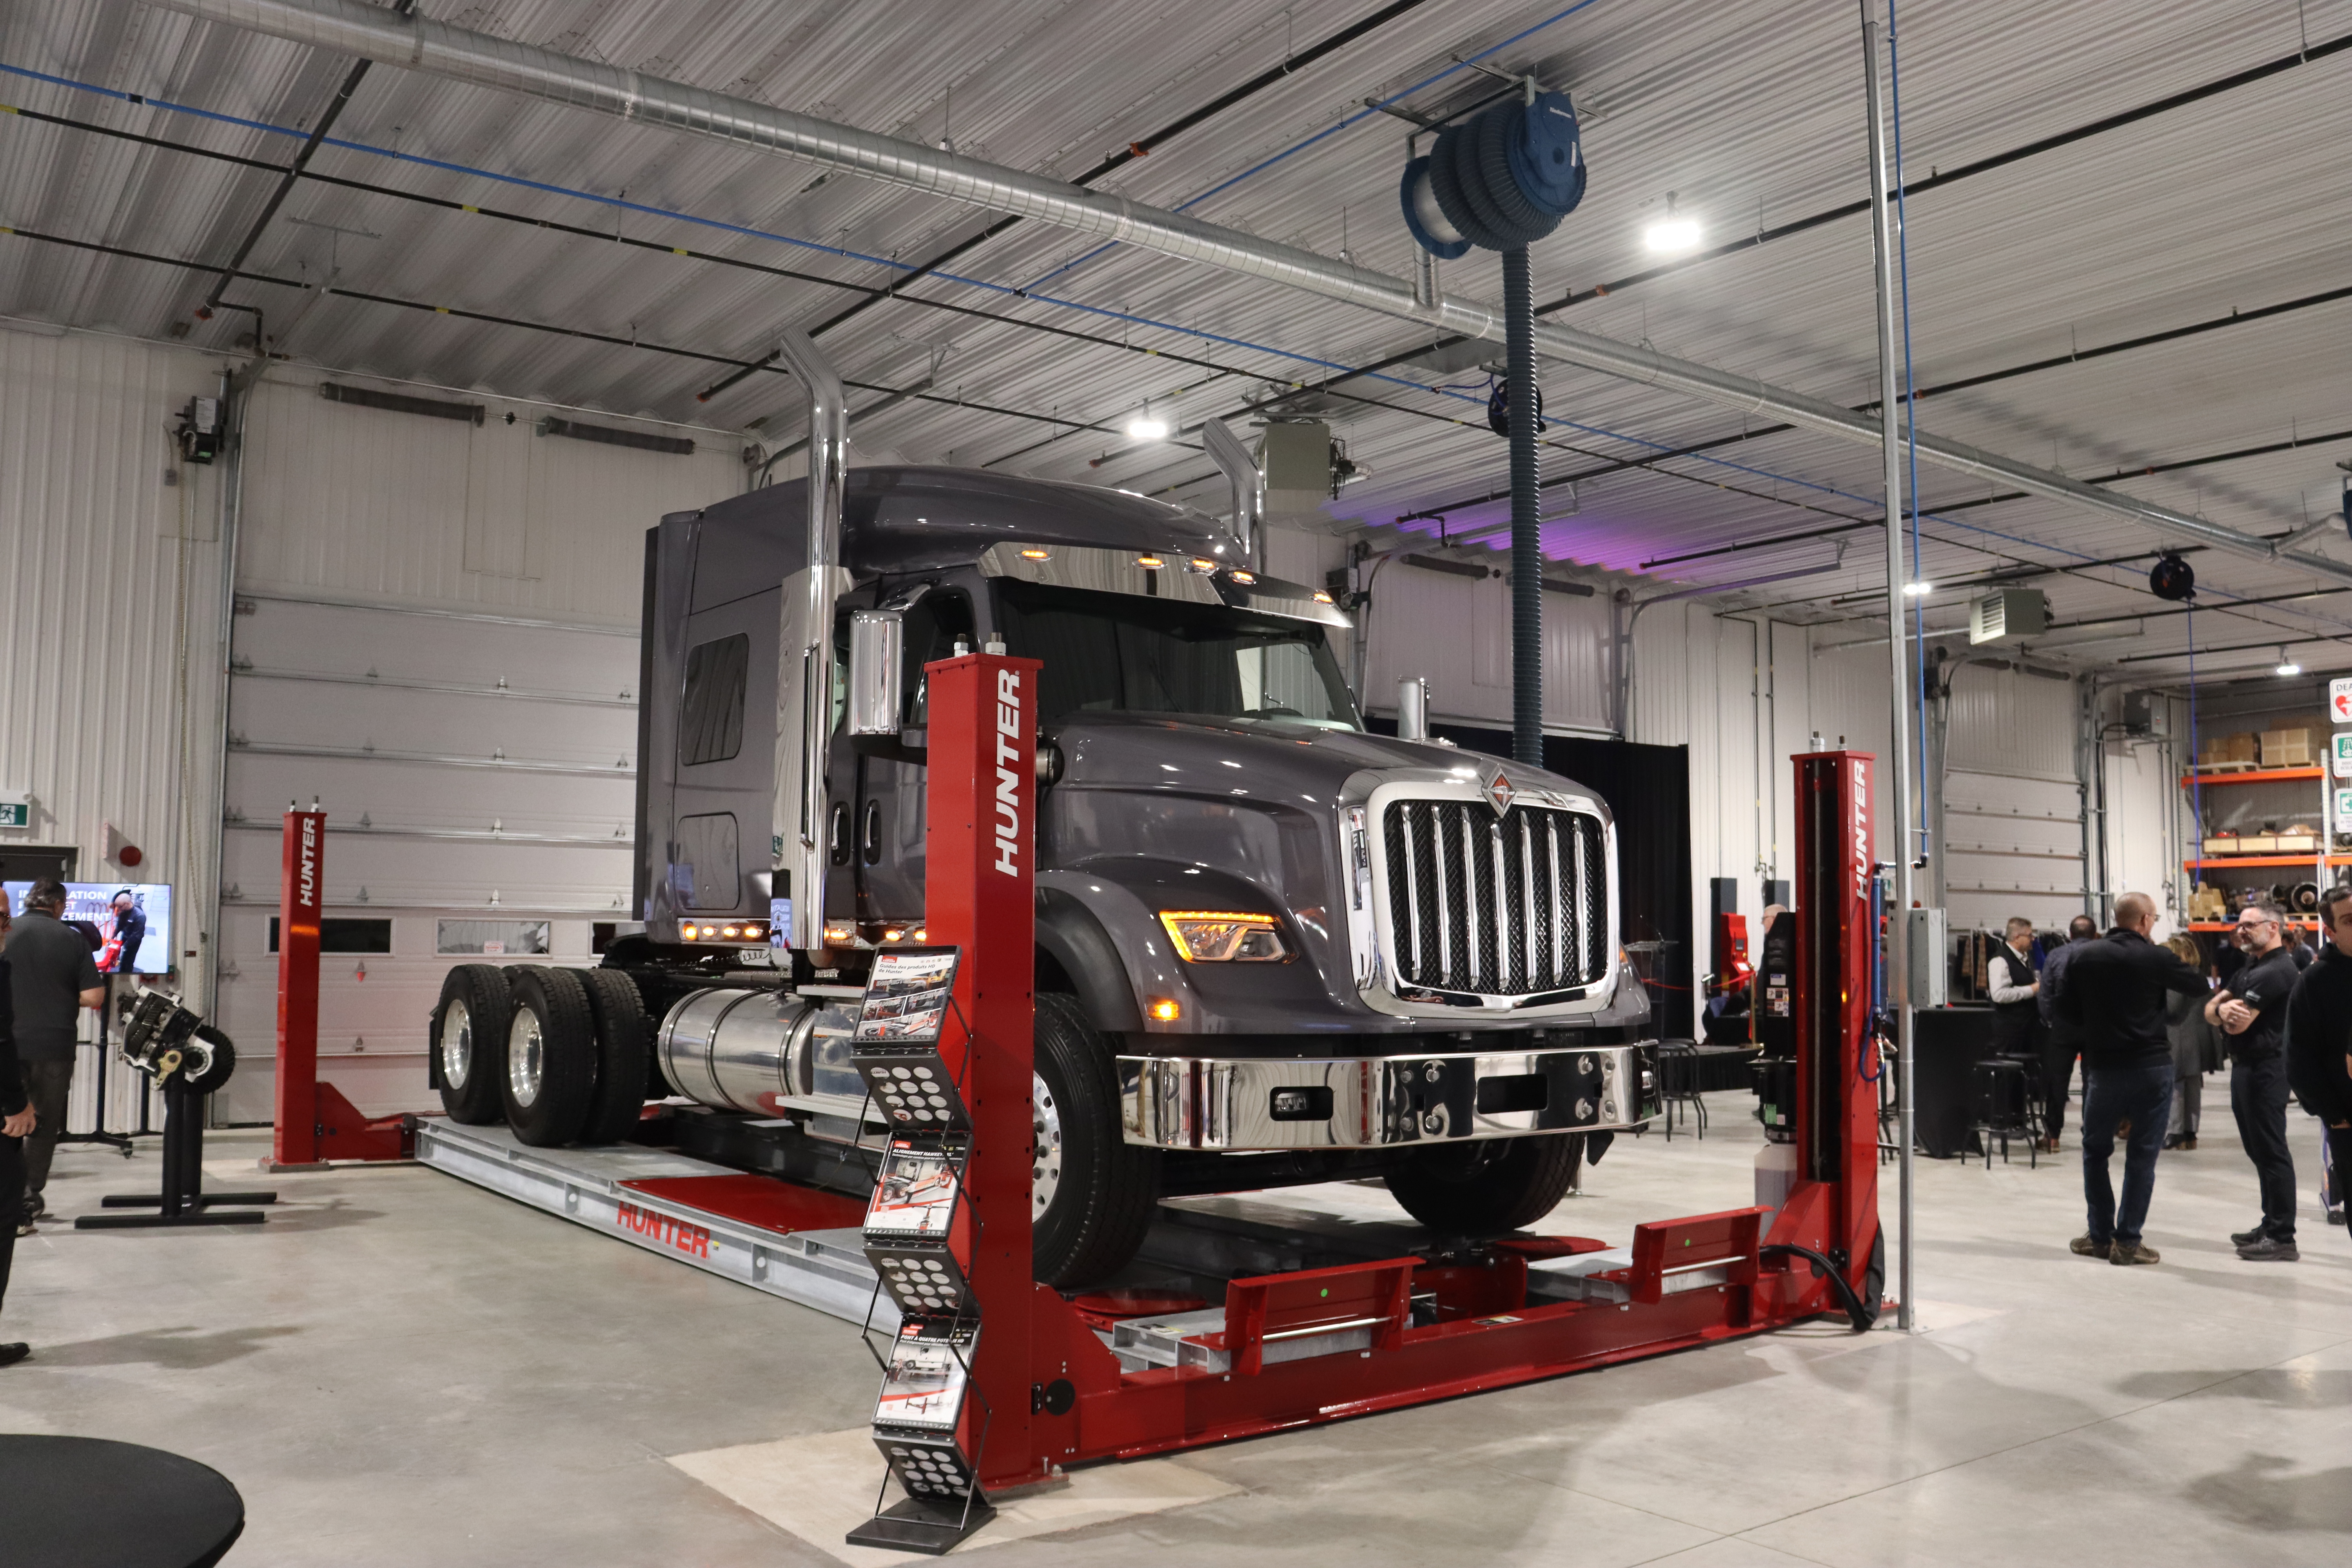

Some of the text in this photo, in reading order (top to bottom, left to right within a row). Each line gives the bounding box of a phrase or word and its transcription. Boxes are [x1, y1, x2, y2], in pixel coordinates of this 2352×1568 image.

[995, 669, 1020, 877] HUNTER
[1854, 760, 1867, 901] HUNTER
[300, 817, 315, 906] HUNTER
[617, 1201, 710, 1258] HUNTER
